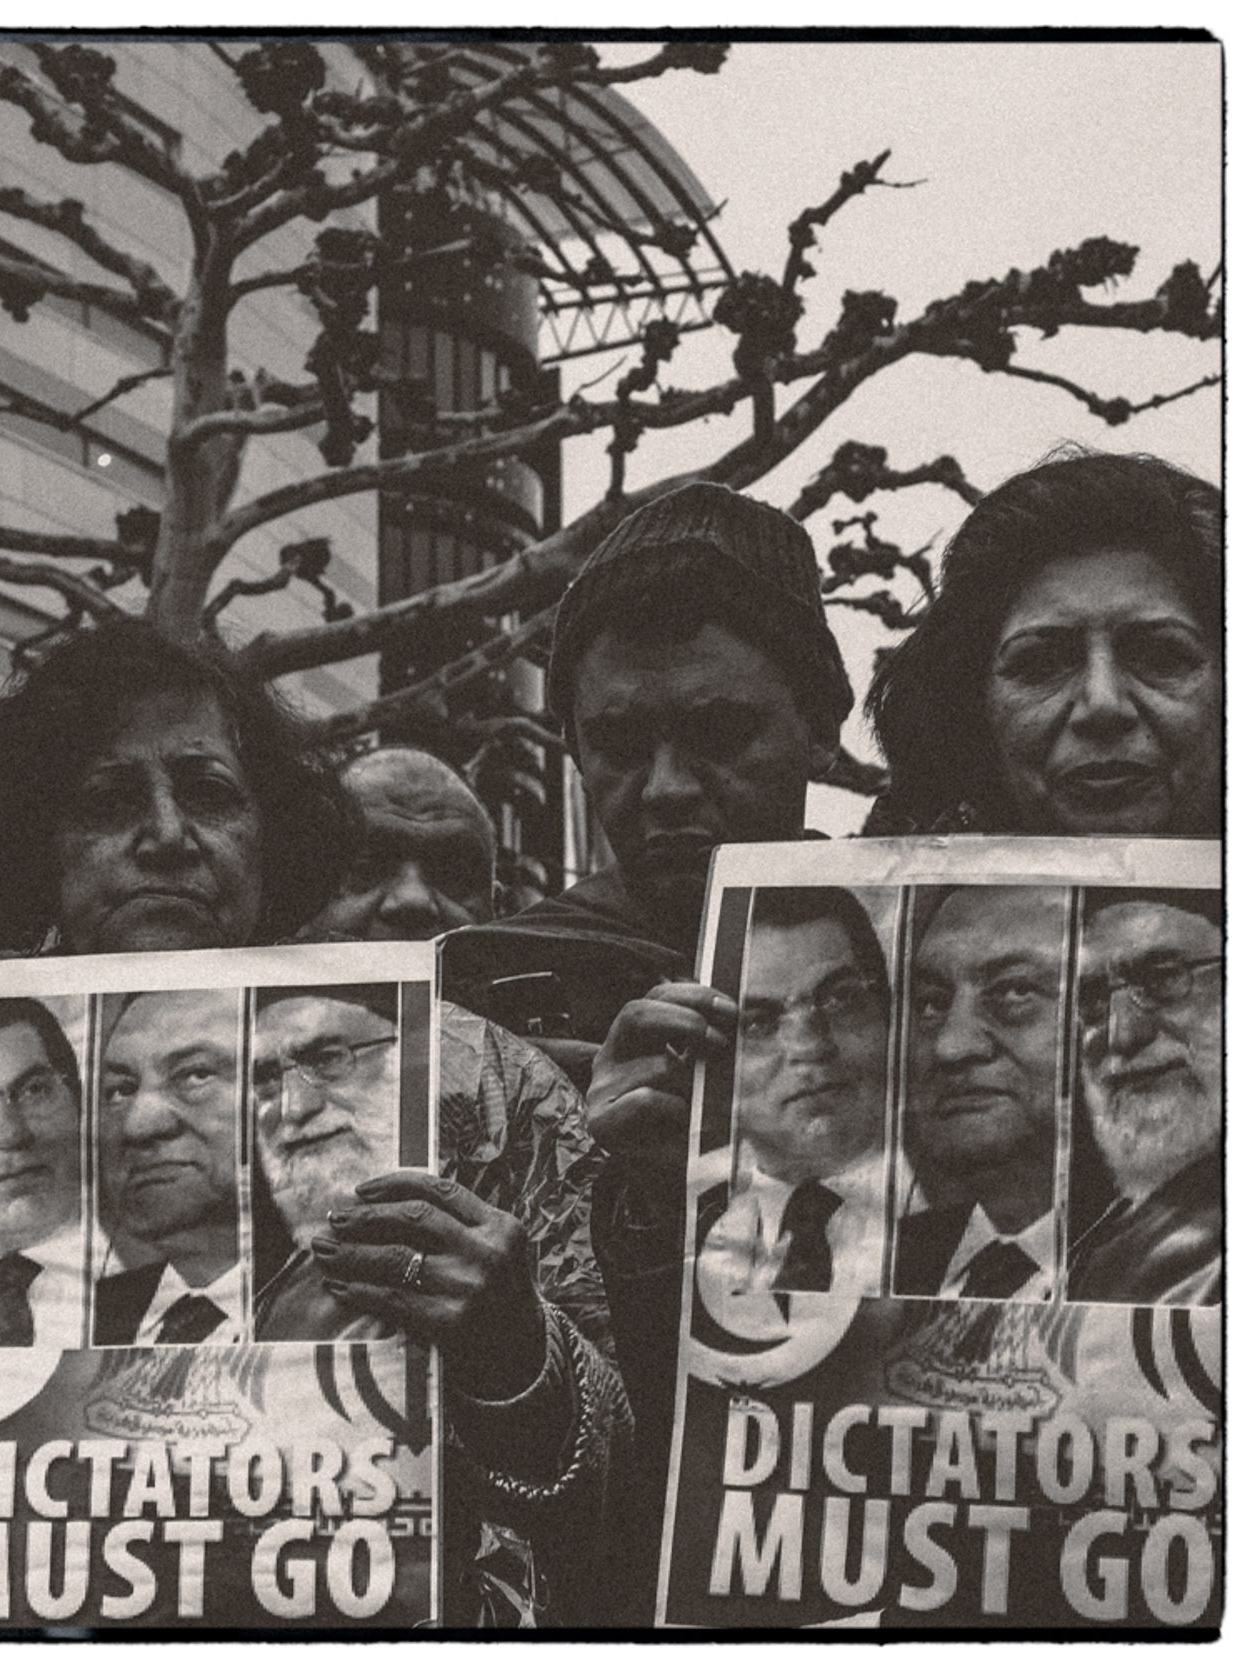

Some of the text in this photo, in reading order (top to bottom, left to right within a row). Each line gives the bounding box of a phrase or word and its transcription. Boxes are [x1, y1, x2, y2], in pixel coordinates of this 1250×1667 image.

[722, 1401, 1218, 1509] DICTATORS
[250, 1518, 396, 1619] GO
[709, 1490, 1214, 1625] MUST GO
